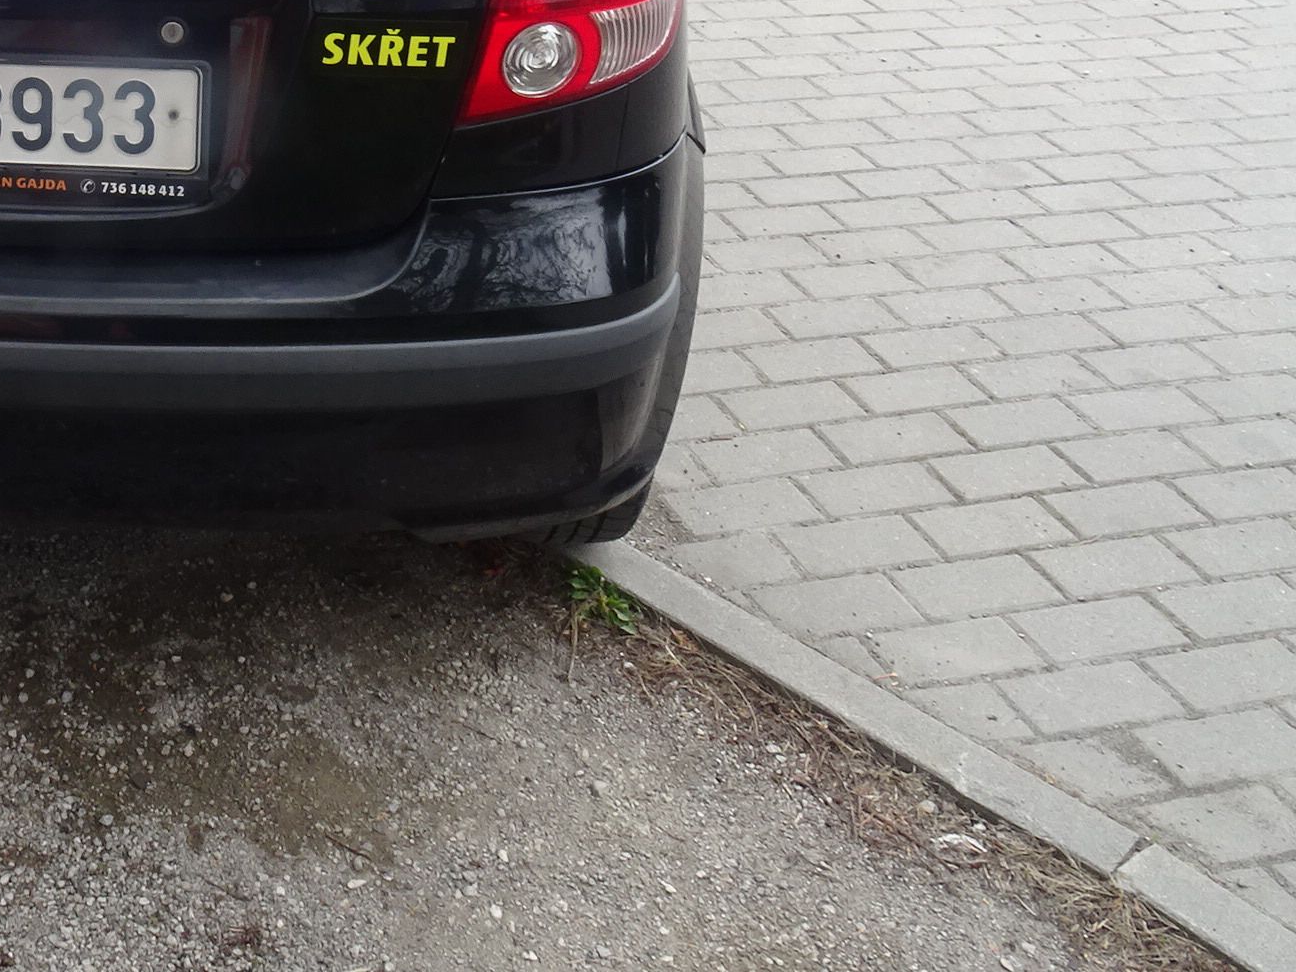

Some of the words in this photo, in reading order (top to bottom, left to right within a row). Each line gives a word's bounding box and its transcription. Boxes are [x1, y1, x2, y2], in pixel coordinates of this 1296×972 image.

[321, 28, 456, 67] SKŘET
[16, 176, 67, 191] GAJDA
[101, 182, 127, 194] 736
[130, 183, 156, 196] 148
[159, 185, 185, 197] 412
